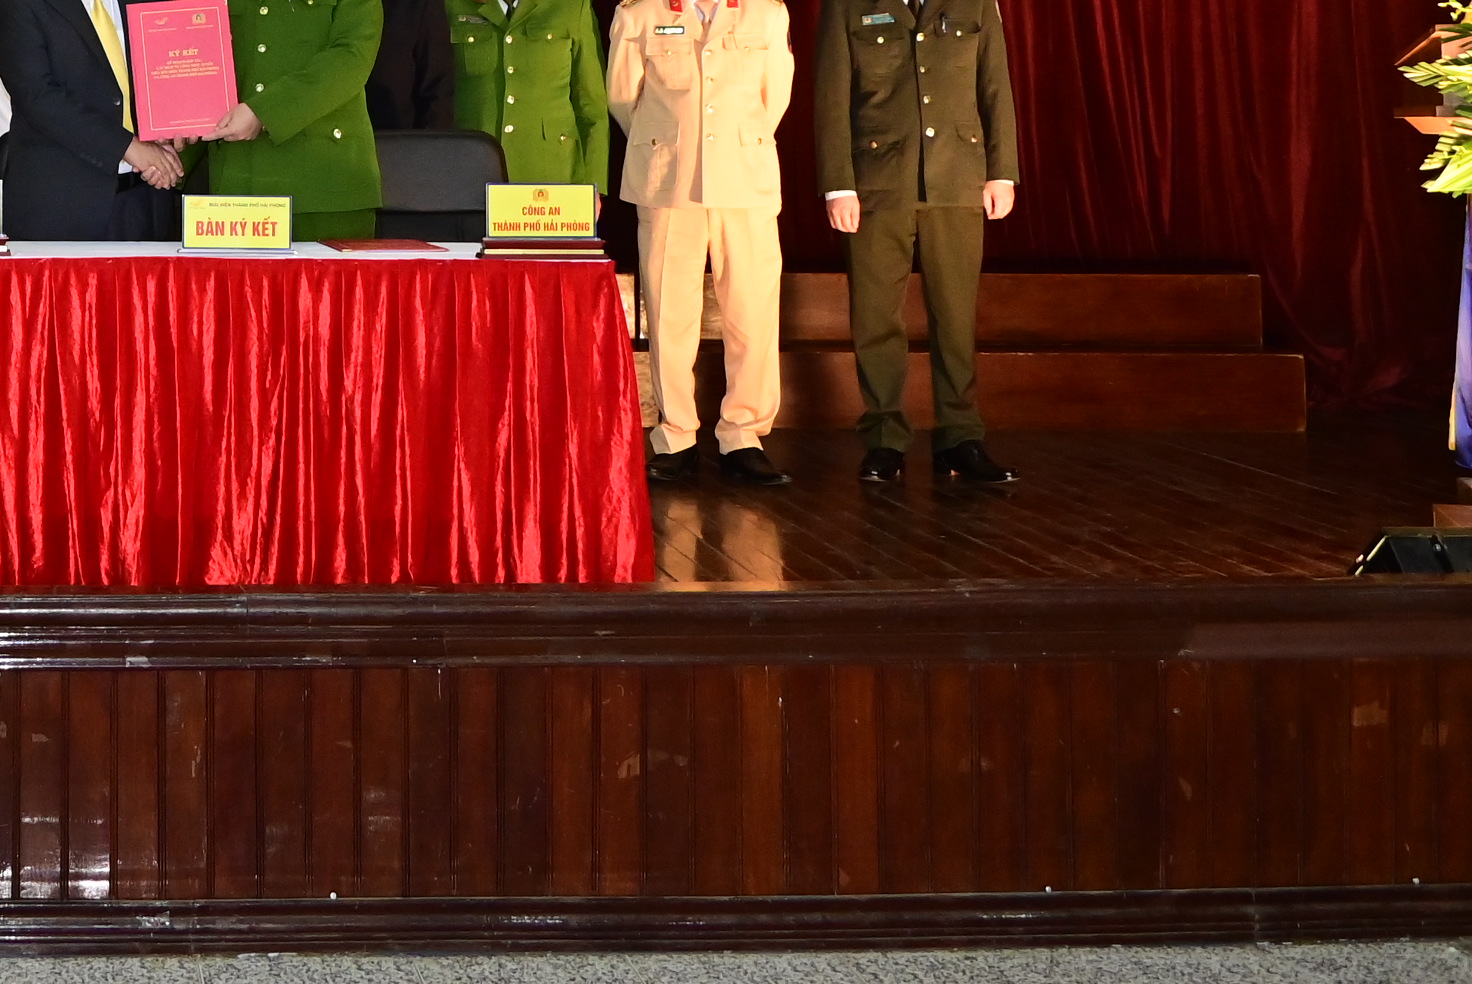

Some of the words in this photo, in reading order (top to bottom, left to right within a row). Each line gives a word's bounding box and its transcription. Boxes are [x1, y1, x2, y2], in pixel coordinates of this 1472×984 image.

[522, 204, 546, 216] CÔNG
[548, 206, 561, 216] AN
[196, 217, 225, 236] BÀN
[230, 217, 248, 237] KÝ
[252, 216, 278, 237] KẾT
[493, 220, 521, 232] THÀNH
[523, 219, 541, 232] PHỐ
[544, 219, 558, 232] HẢI
[561, 220, 590, 232] PHÒNG
